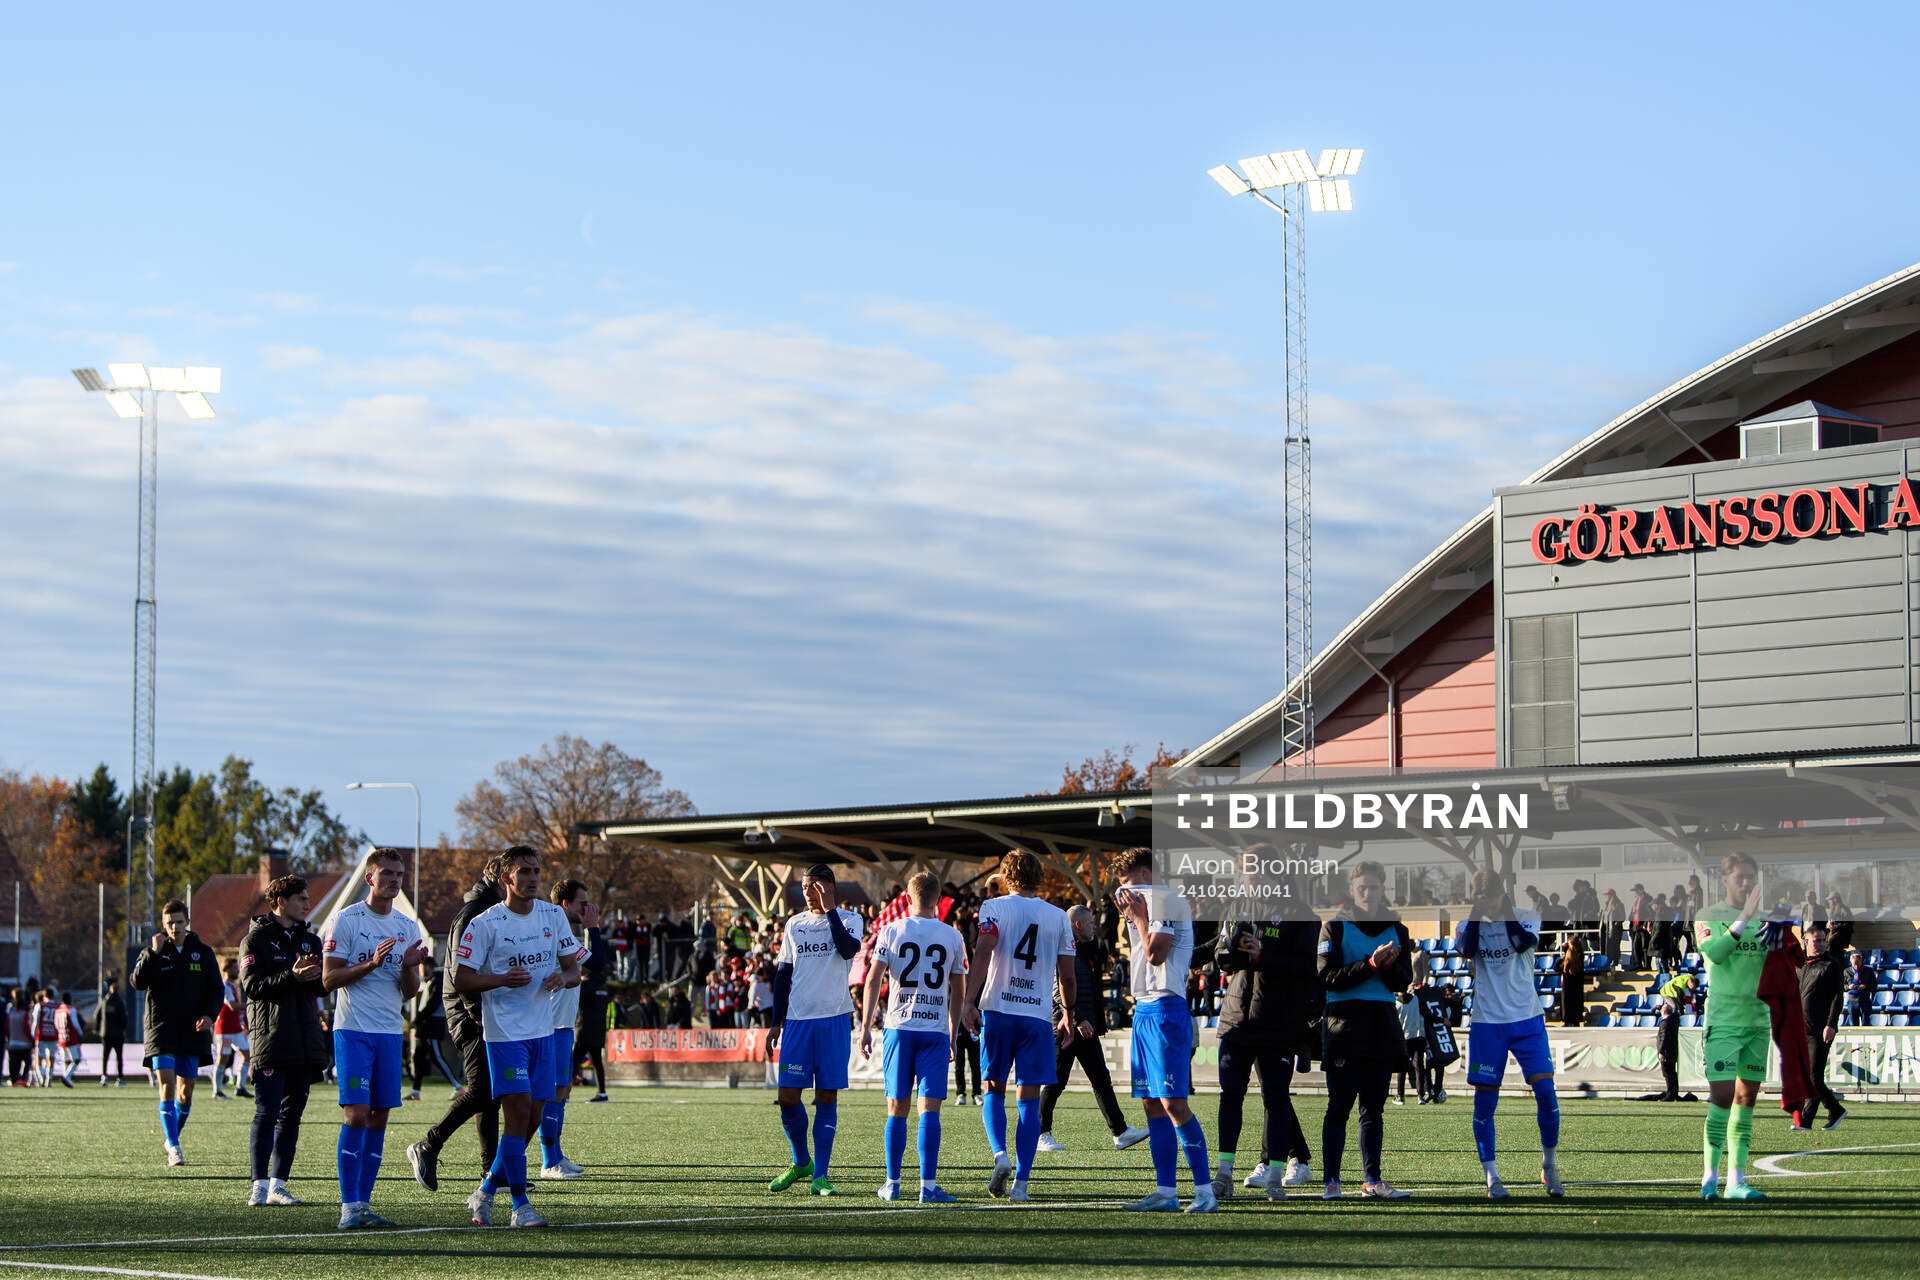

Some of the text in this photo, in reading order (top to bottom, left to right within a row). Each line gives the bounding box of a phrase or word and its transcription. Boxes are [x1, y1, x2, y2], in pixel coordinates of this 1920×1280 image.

[1531, 482, 1869, 565] GÖRANSSON
[1265, 927, 1280, 938] XXL
[559, 936, 575, 949] XXL
[797, 941, 828, 954] akea
[1014, 923, 1039, 970] 4
[1736, 942, 1757, 951] kea
[358, 948, 393, 963] aka
[508, 951, 542, 968] akea
[1479, 947, 1510, 959] akea
[899, 941, 947, 989] 23
[1010, 976, 1036, 990] ROGNE
[899, 993, 944, 1006] WESERLUND
[1001, 991, 1041, 1006] tillmobil
[1426, 1000, 1454, 1053] SELCT
[682, 1030, 738, 1050] FLANKEN
